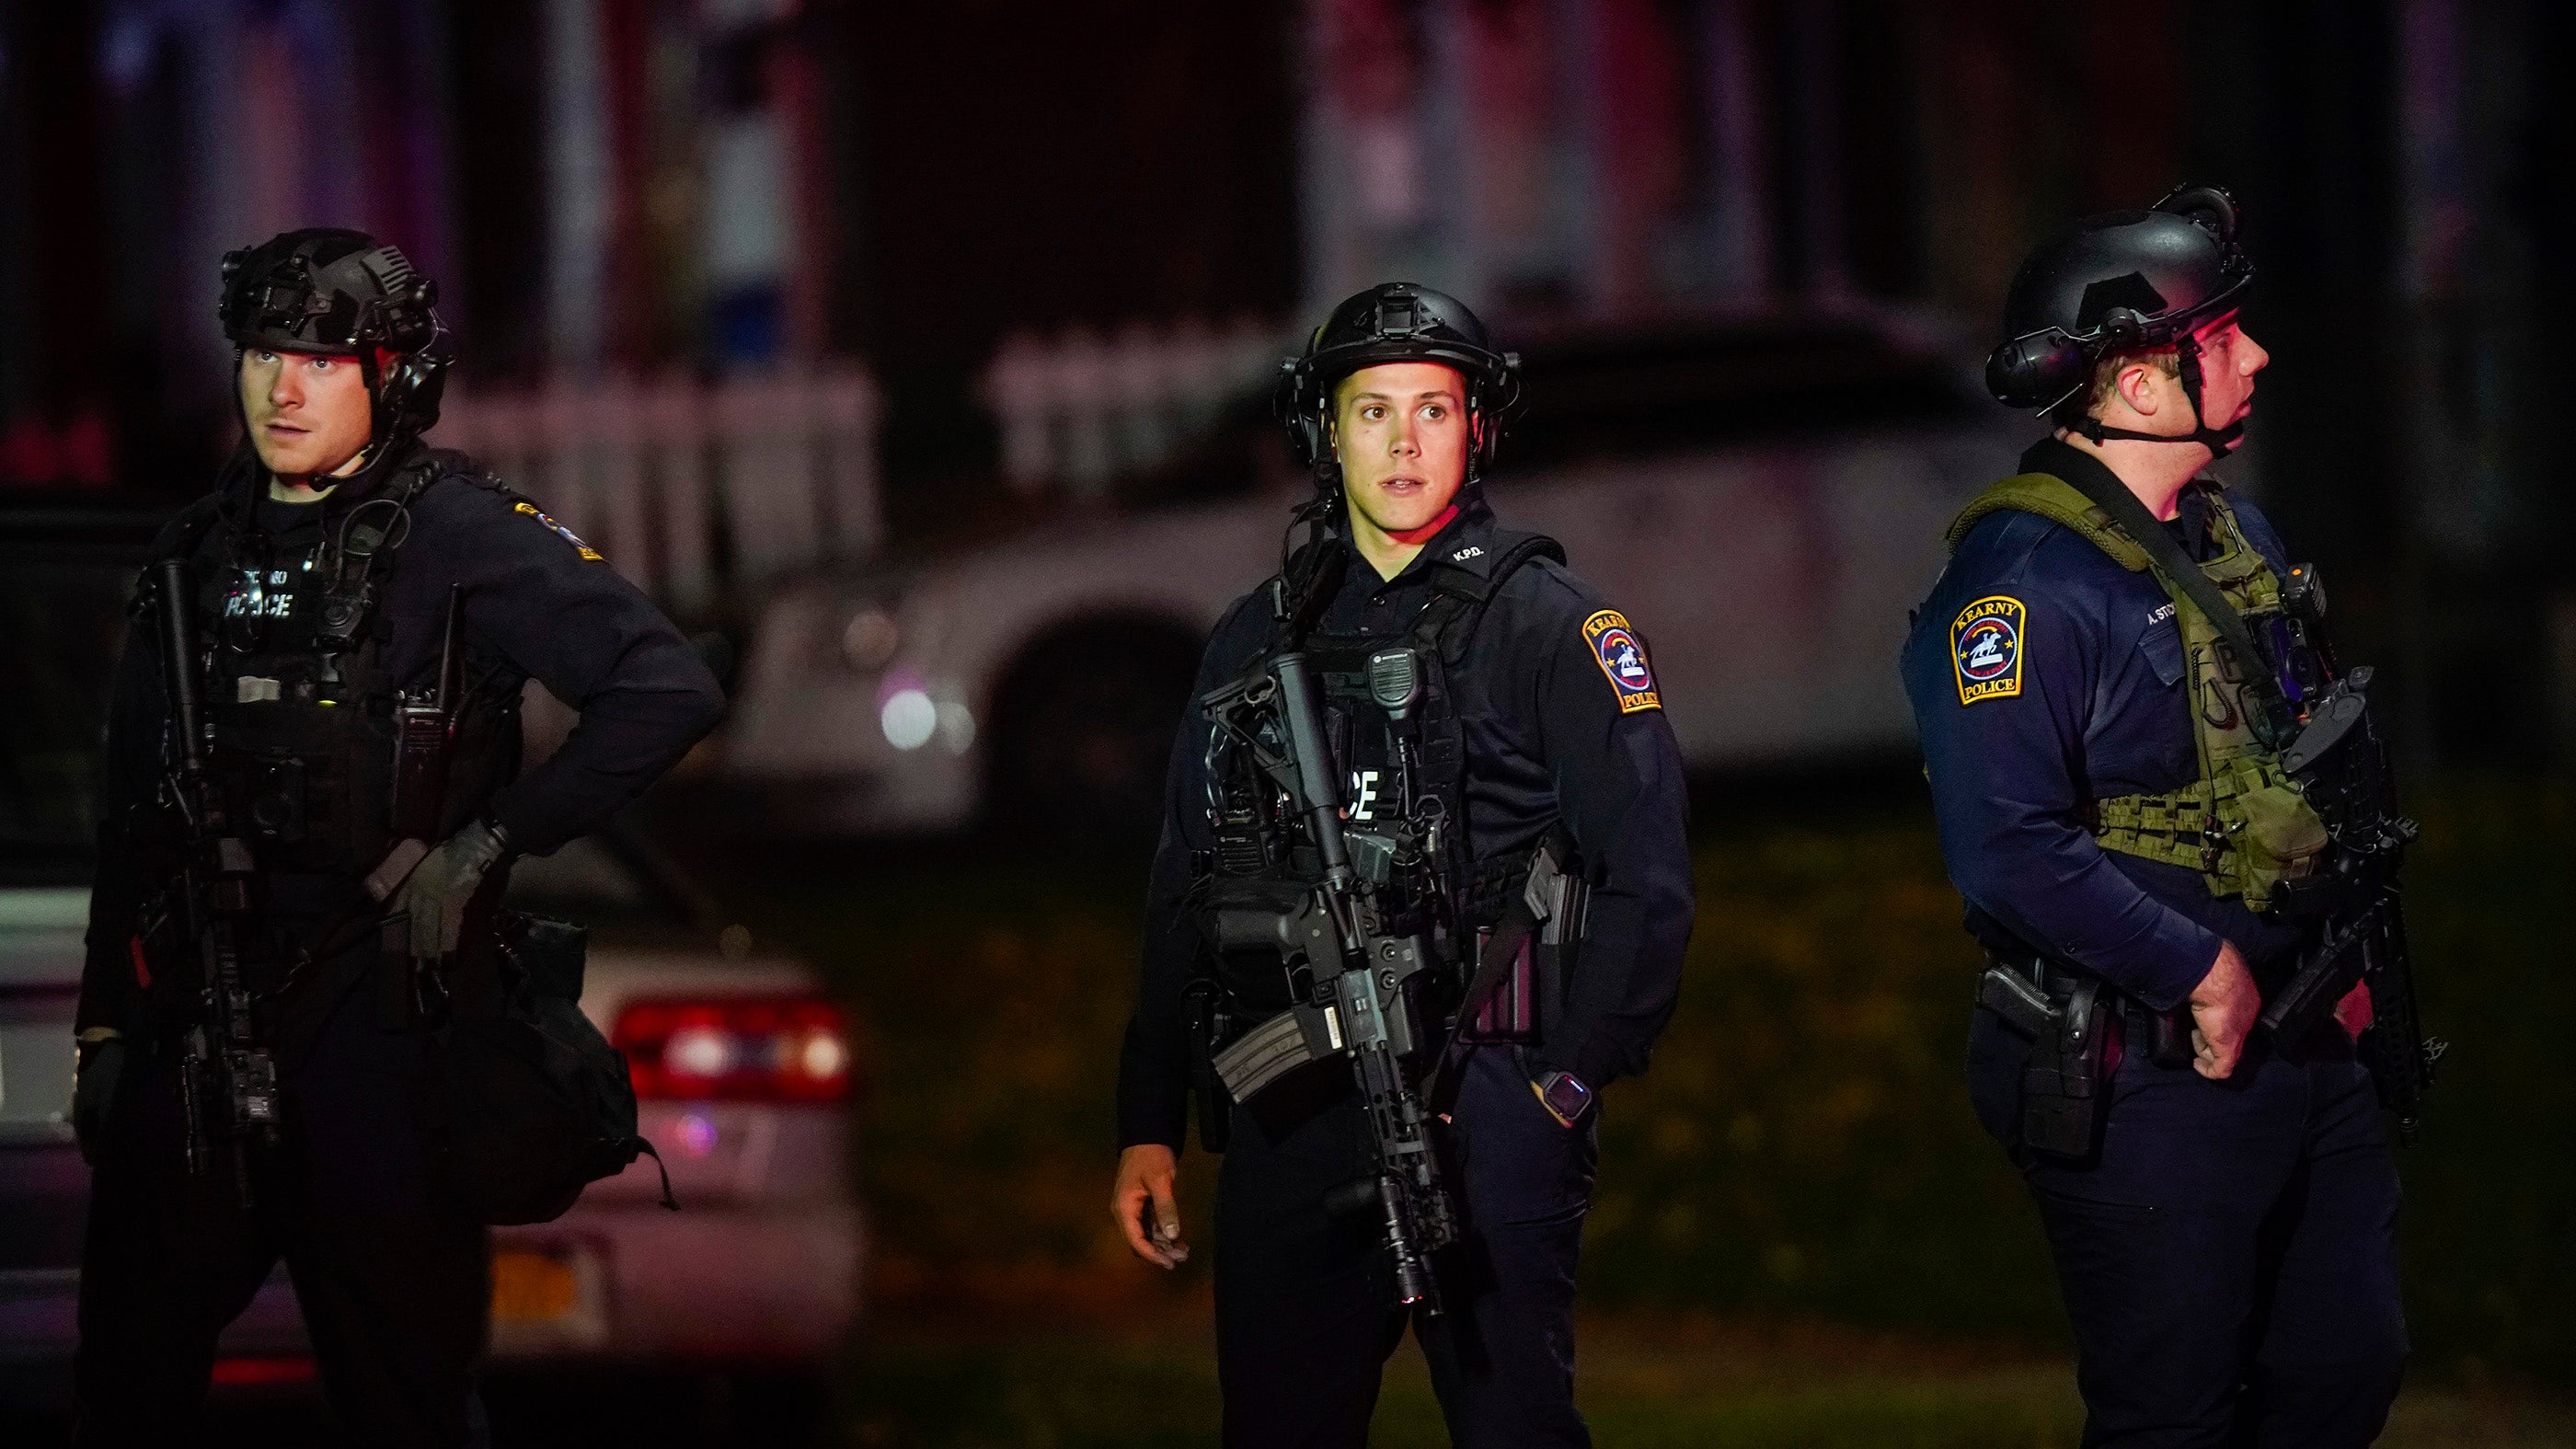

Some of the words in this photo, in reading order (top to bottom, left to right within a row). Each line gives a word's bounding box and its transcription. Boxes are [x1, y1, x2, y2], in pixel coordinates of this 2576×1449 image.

[224, 593, 293, 617] POICE
[1956, 602, 2018, 631] KEARNY
[1964, 678, 2016, 699] POLICE
